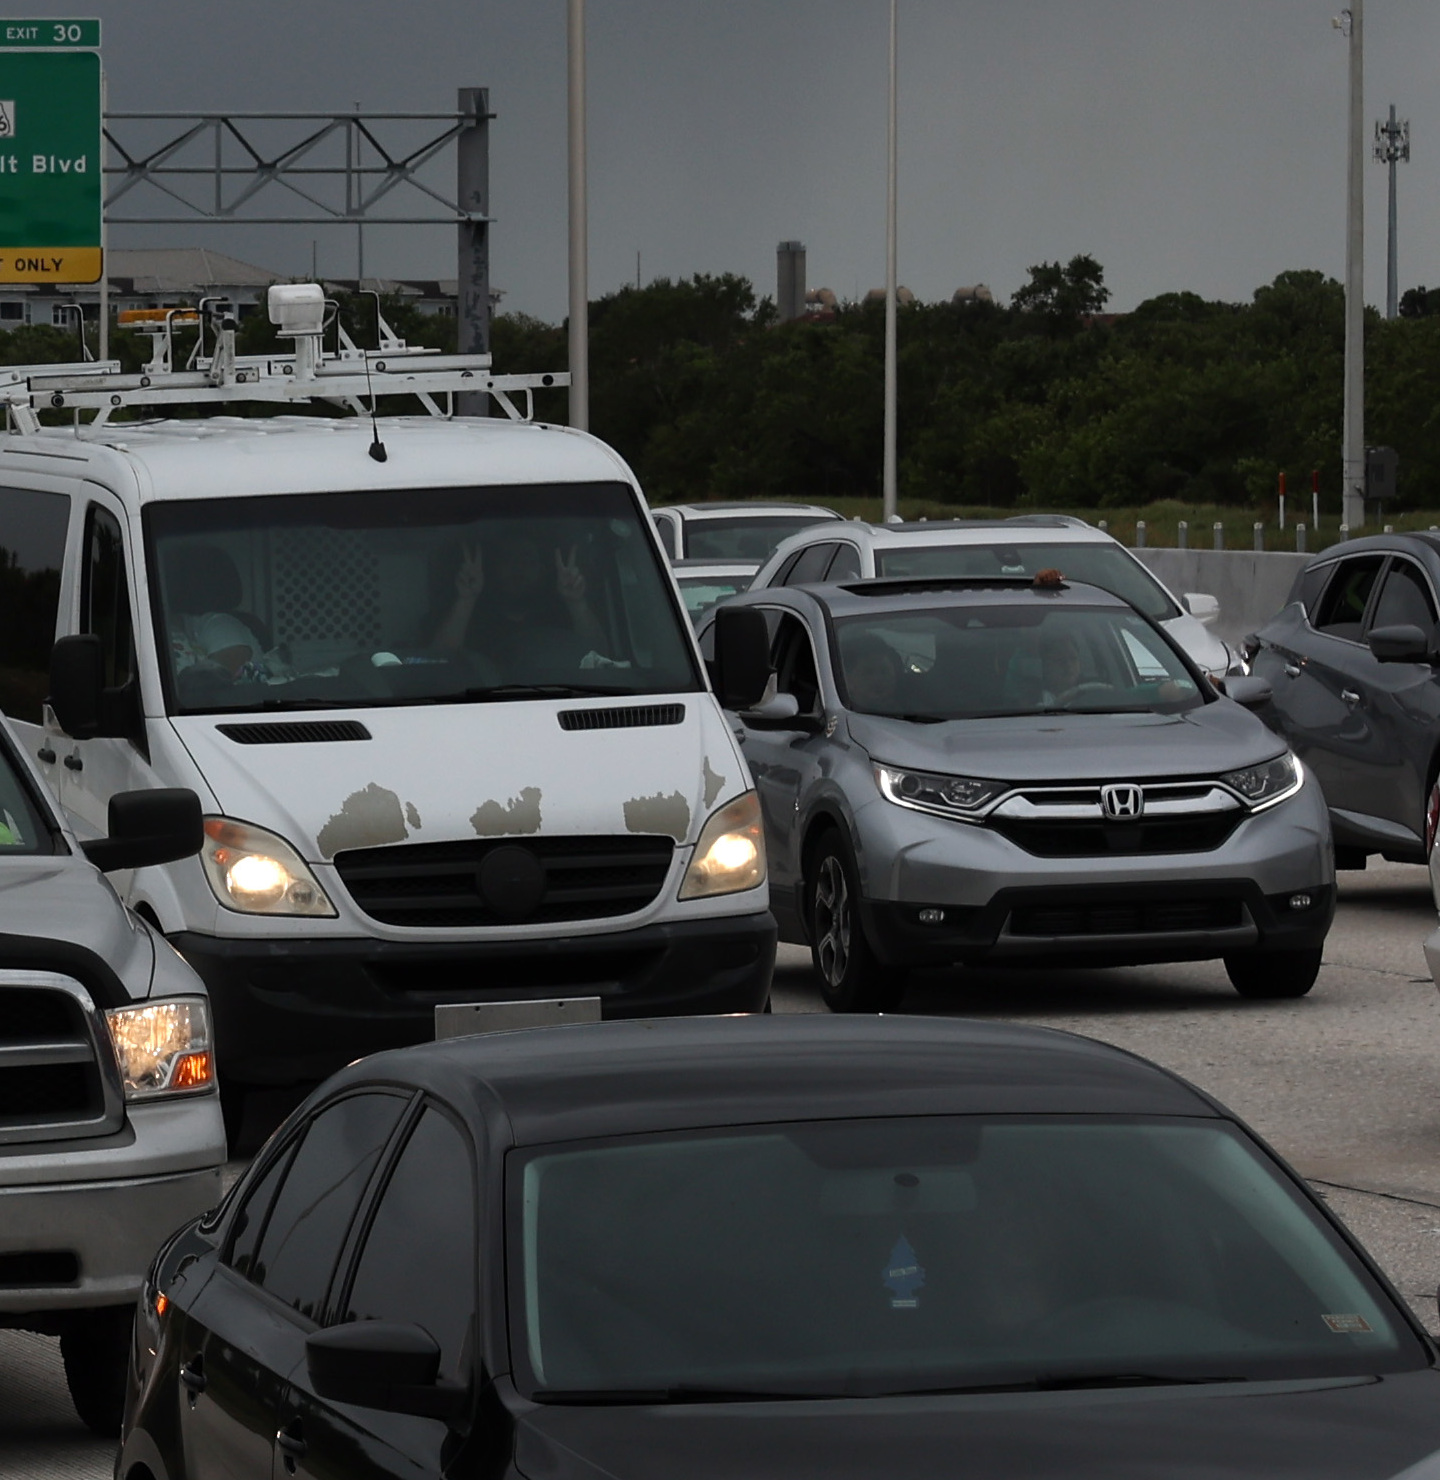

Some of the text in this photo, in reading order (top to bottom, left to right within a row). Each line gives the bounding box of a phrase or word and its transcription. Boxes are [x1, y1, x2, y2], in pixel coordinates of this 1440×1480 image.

[6, 24, 81, 42] EXIT 30
[32, 154, 87, 174] Blvd
[15, 257, 63, 272] ONLY
